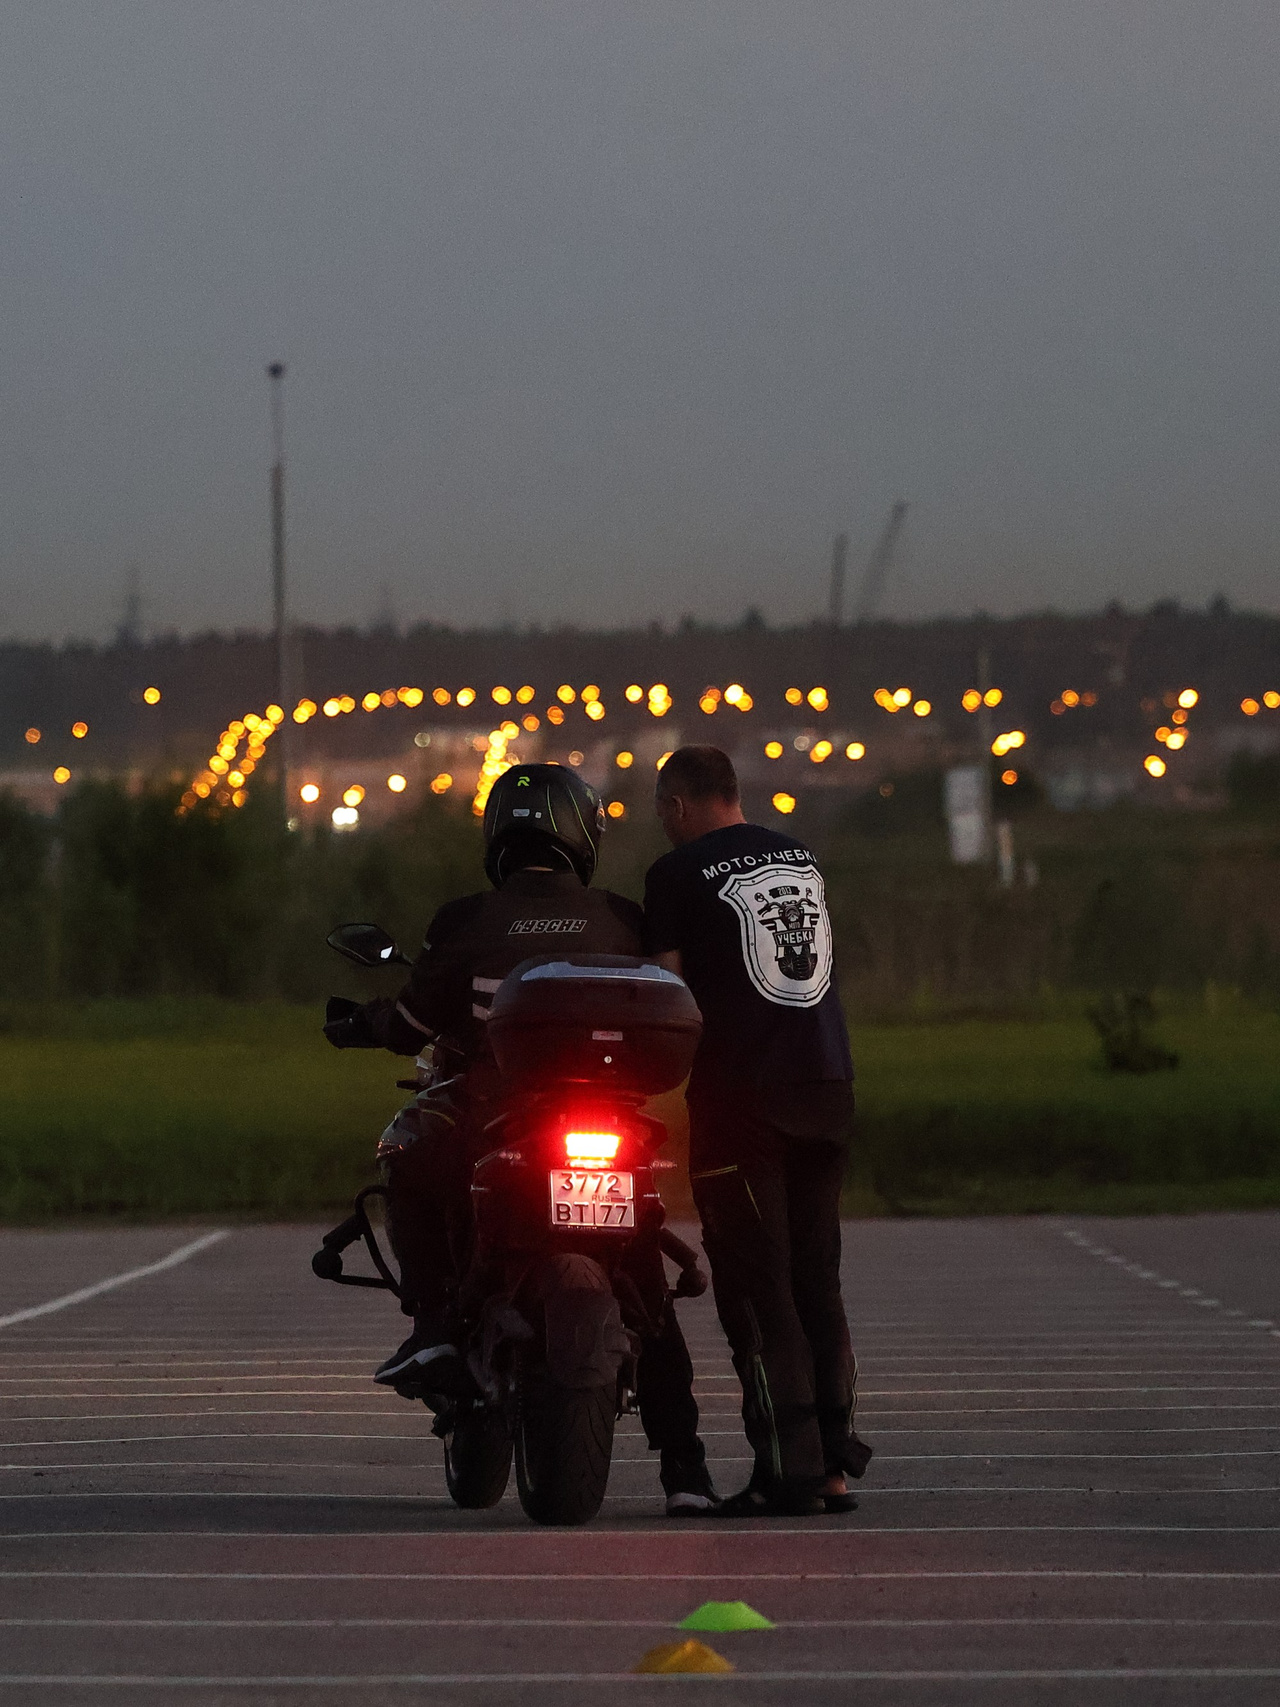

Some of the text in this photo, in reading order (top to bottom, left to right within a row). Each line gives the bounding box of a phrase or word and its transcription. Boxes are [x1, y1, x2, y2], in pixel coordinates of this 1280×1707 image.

[777, 887, 793, 896] 2013
[777, 930, 813, 944] УЧЕБКА
[560, 1173, 620, 1193] 3772
[600, 1204, 628, 1224] 77
